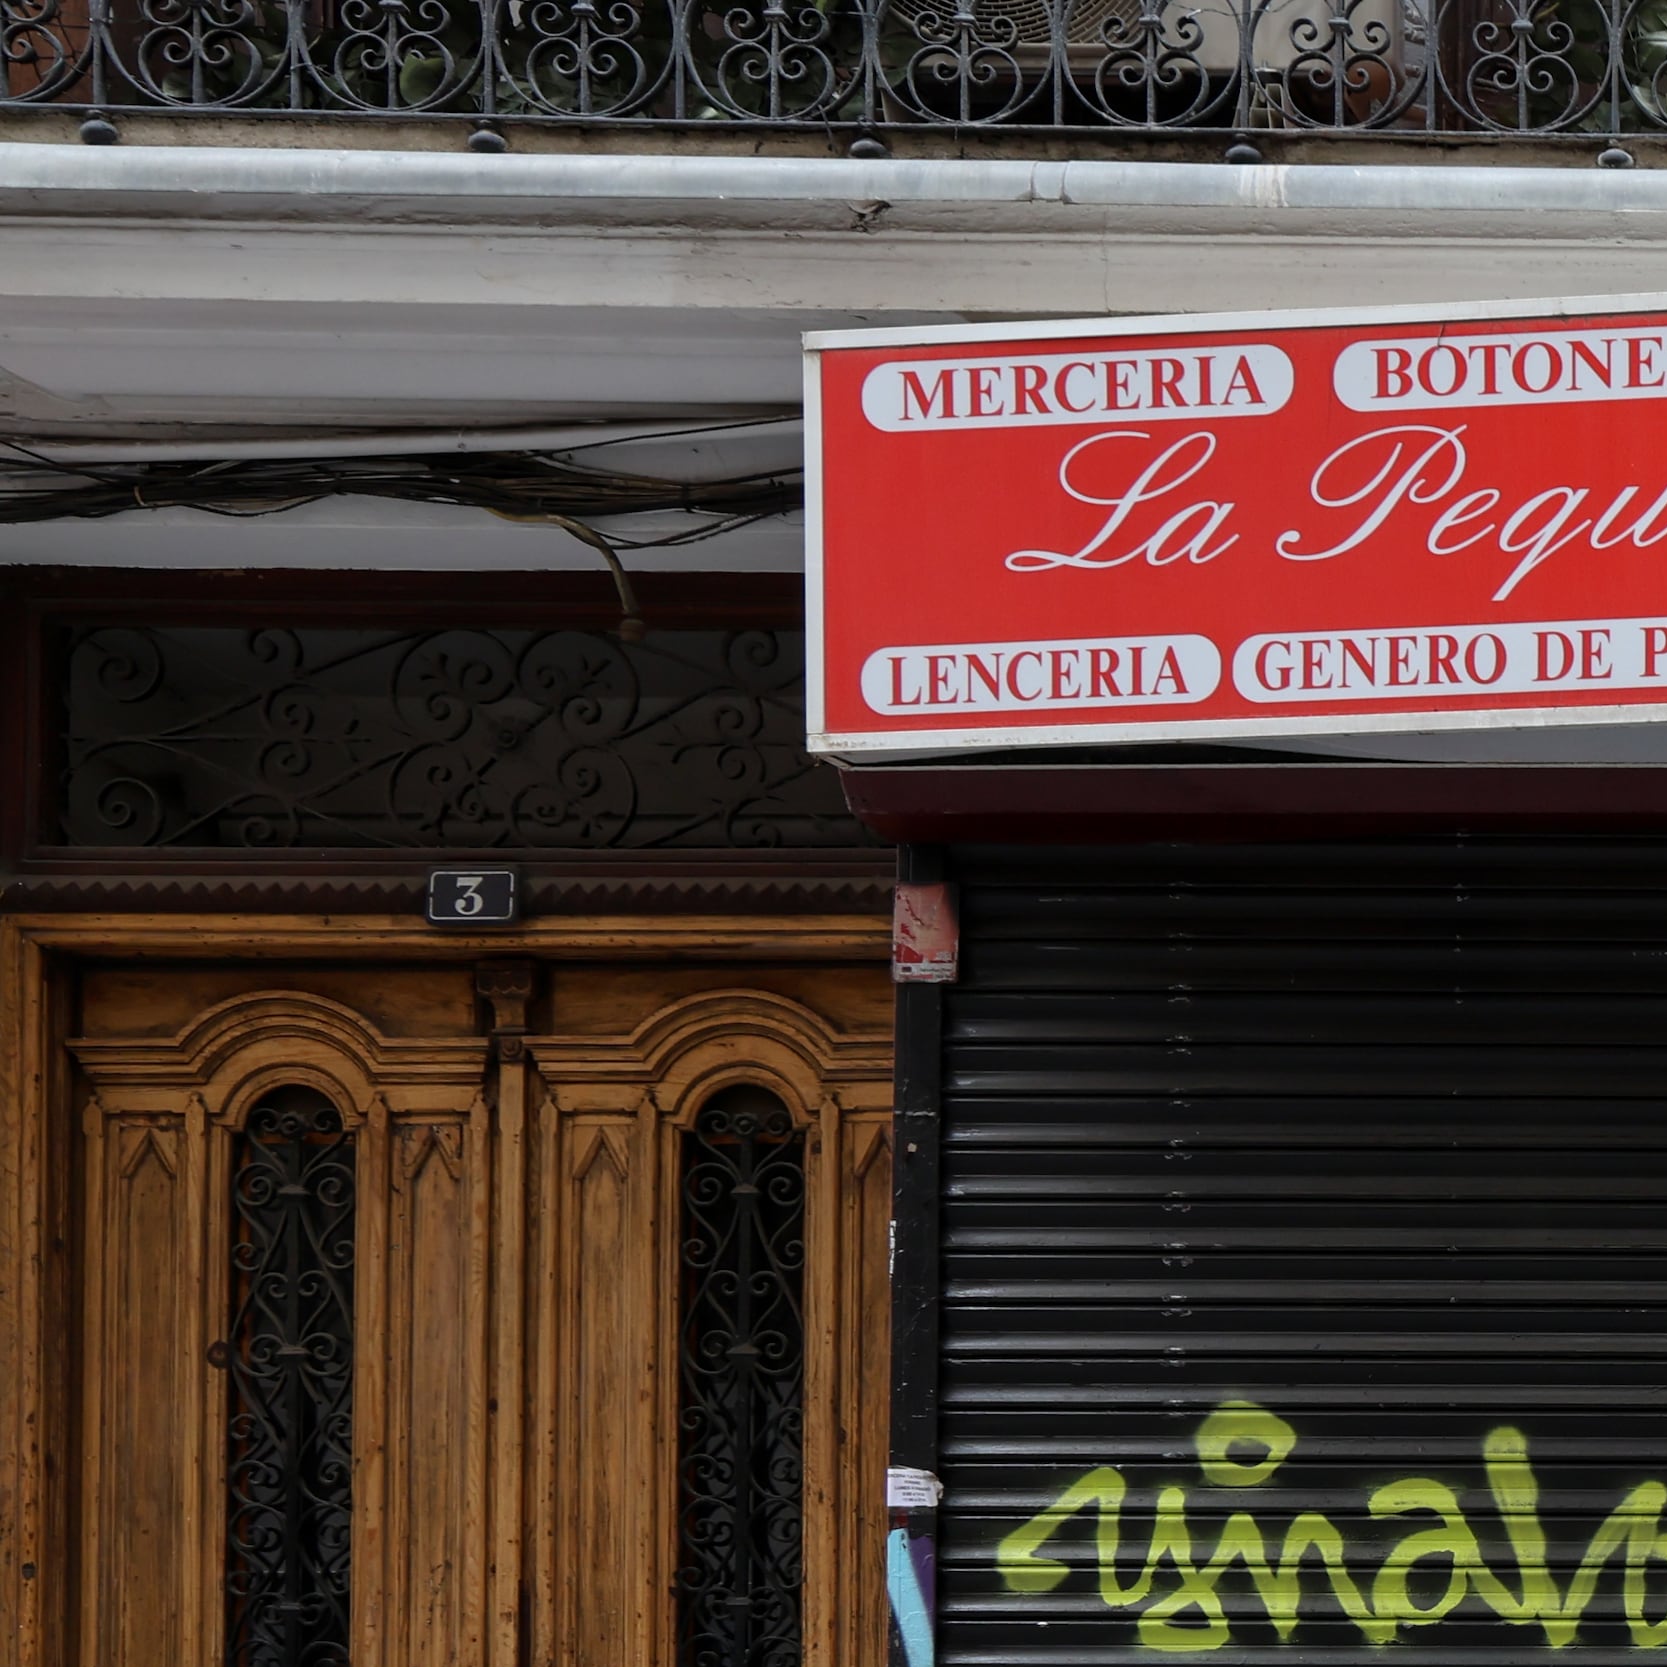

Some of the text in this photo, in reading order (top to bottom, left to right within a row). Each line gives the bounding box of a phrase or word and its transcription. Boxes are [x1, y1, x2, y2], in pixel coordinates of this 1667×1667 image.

[897, 354, 1270, 422] MERCERIA
[1004, 430, 1240, 573] La
[886, 644, 1191, 707] LENCERIA
[1254, 630, 1508, 692] GENERO
[1532, 629, 1614, 683] DE
[453, 875, 484, 916] 3
